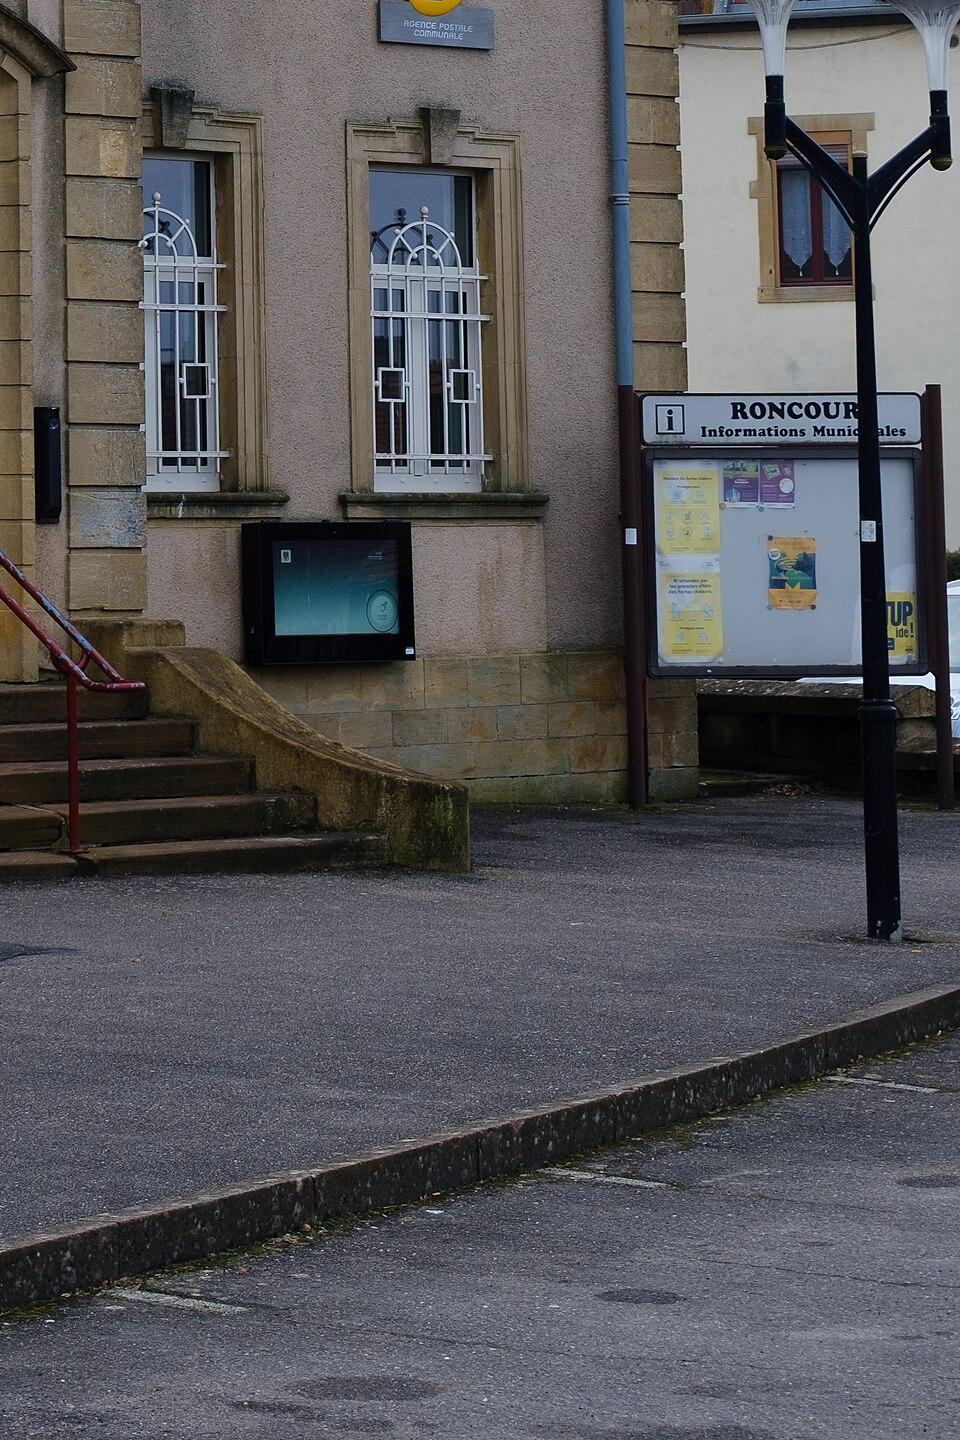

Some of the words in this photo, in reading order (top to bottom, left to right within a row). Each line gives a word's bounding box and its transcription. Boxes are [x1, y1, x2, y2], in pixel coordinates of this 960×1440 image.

[403, 20, 437, 30] AGENCE
[439, 22, 474, 33] POSTALE
[413, 30, 464, 40] COMMUNALE
[731, 401, 860, 420] RONCOUR
[700, 425, 806, 438] Informations
[812, 425, 907, 438] Municales
